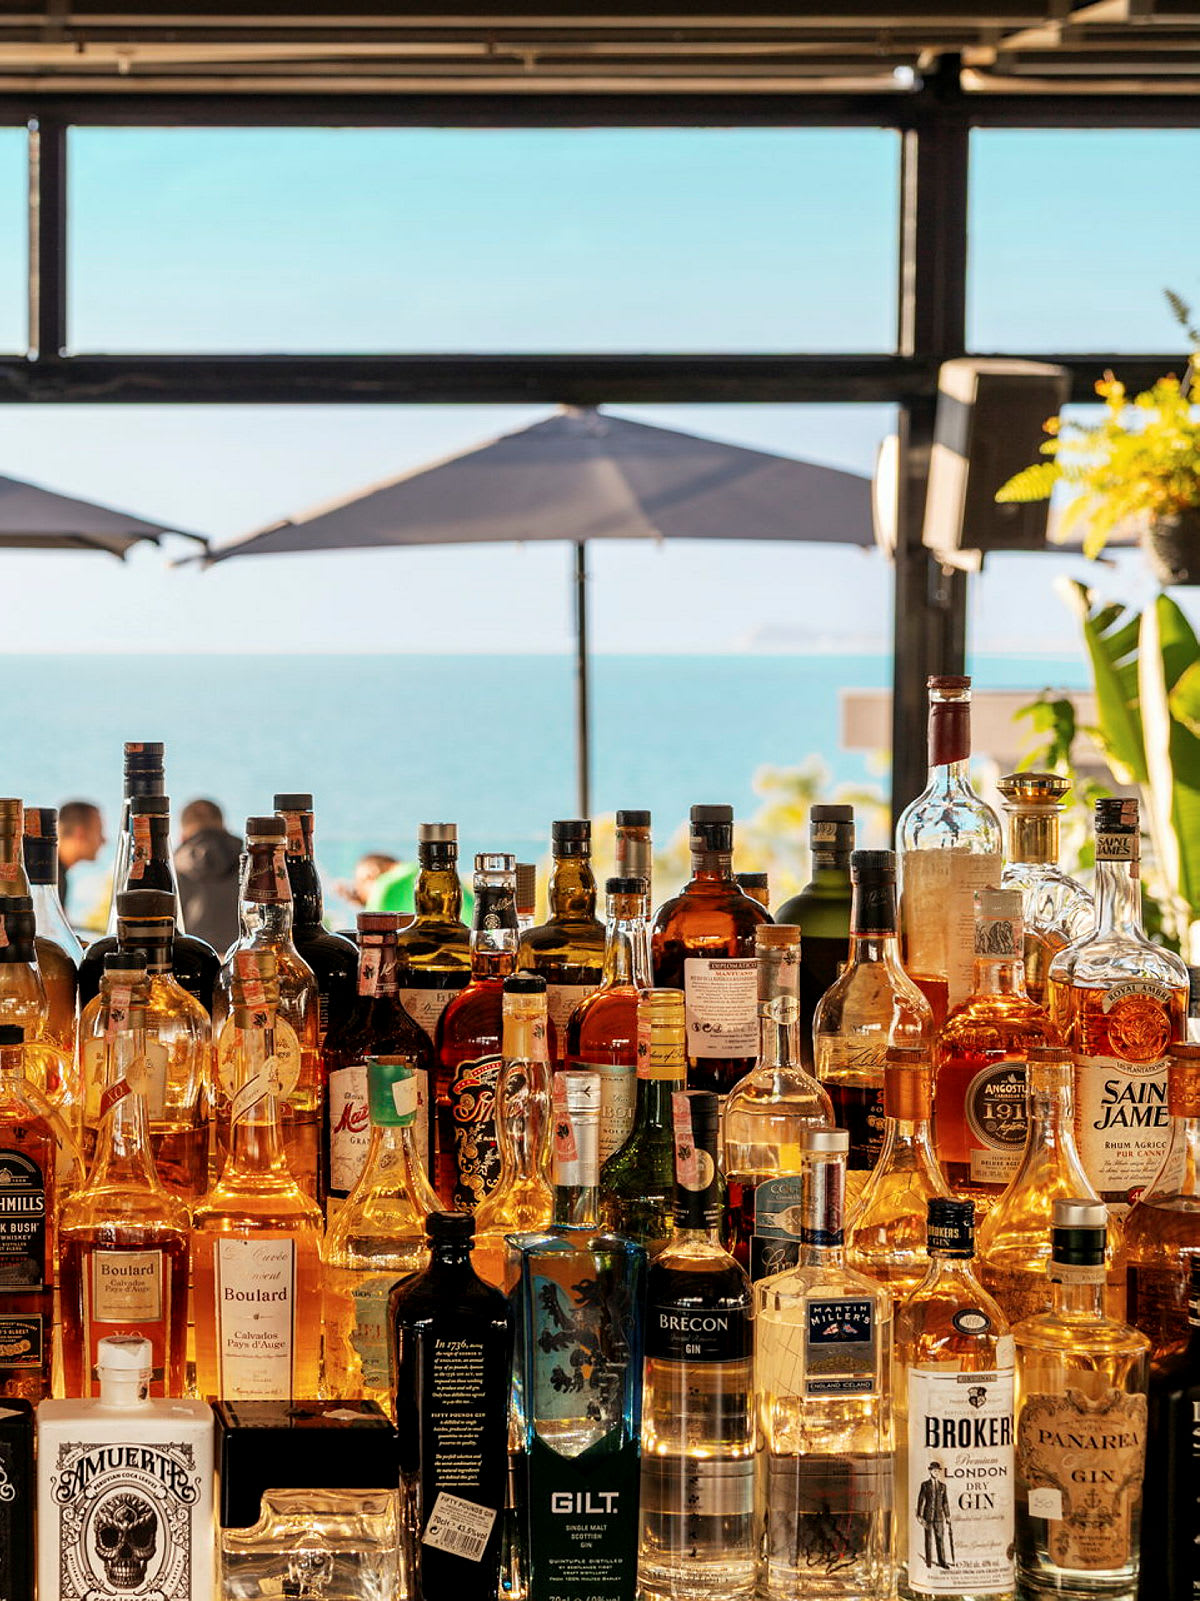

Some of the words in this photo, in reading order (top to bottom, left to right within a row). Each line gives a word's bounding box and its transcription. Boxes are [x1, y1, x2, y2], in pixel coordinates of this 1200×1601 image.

[1098, 837, 1130, 846] SAINT
[1108, 985, 1137, 1001] ROYAL
[1101, 1080, 1168, 1104] SAIN
[983, 1103, 1025, 1120] 191
[1093, 1106, 1169, 1130] JAME
[1105, 1141, 1130, 1149] RHUM
[10, 1223, 37, 1233] BUSH
[101, 1263, 154, 1276] Boulard
[224, 1287, 288, 1302] Boulard
[813, 1305, 868, 1313] MARTIN
[660, 1313, 728, 1331] BRECON
[811, 1313, 871, 1326] MILLER'S
[235, 1331, 278, 1340] Calvados
[227, 1340, 249, 1349] Pays
[251, 1340, 286, 1349] d'Auge
[435, 1339, 445, 1348] In
[686, 1344, 701, 1354] GIN
[1038, 1430, 1139, 1449] PANAREA
[56, 1447, 196, 1504] AMUERTE
[944, 1467, 1007, 1478] LONDON
[1071, 1469, 1114, 1483] GIN
[966, 1482, 990, 1491] DRY
[959, 1493, 995, 1509] GIN
